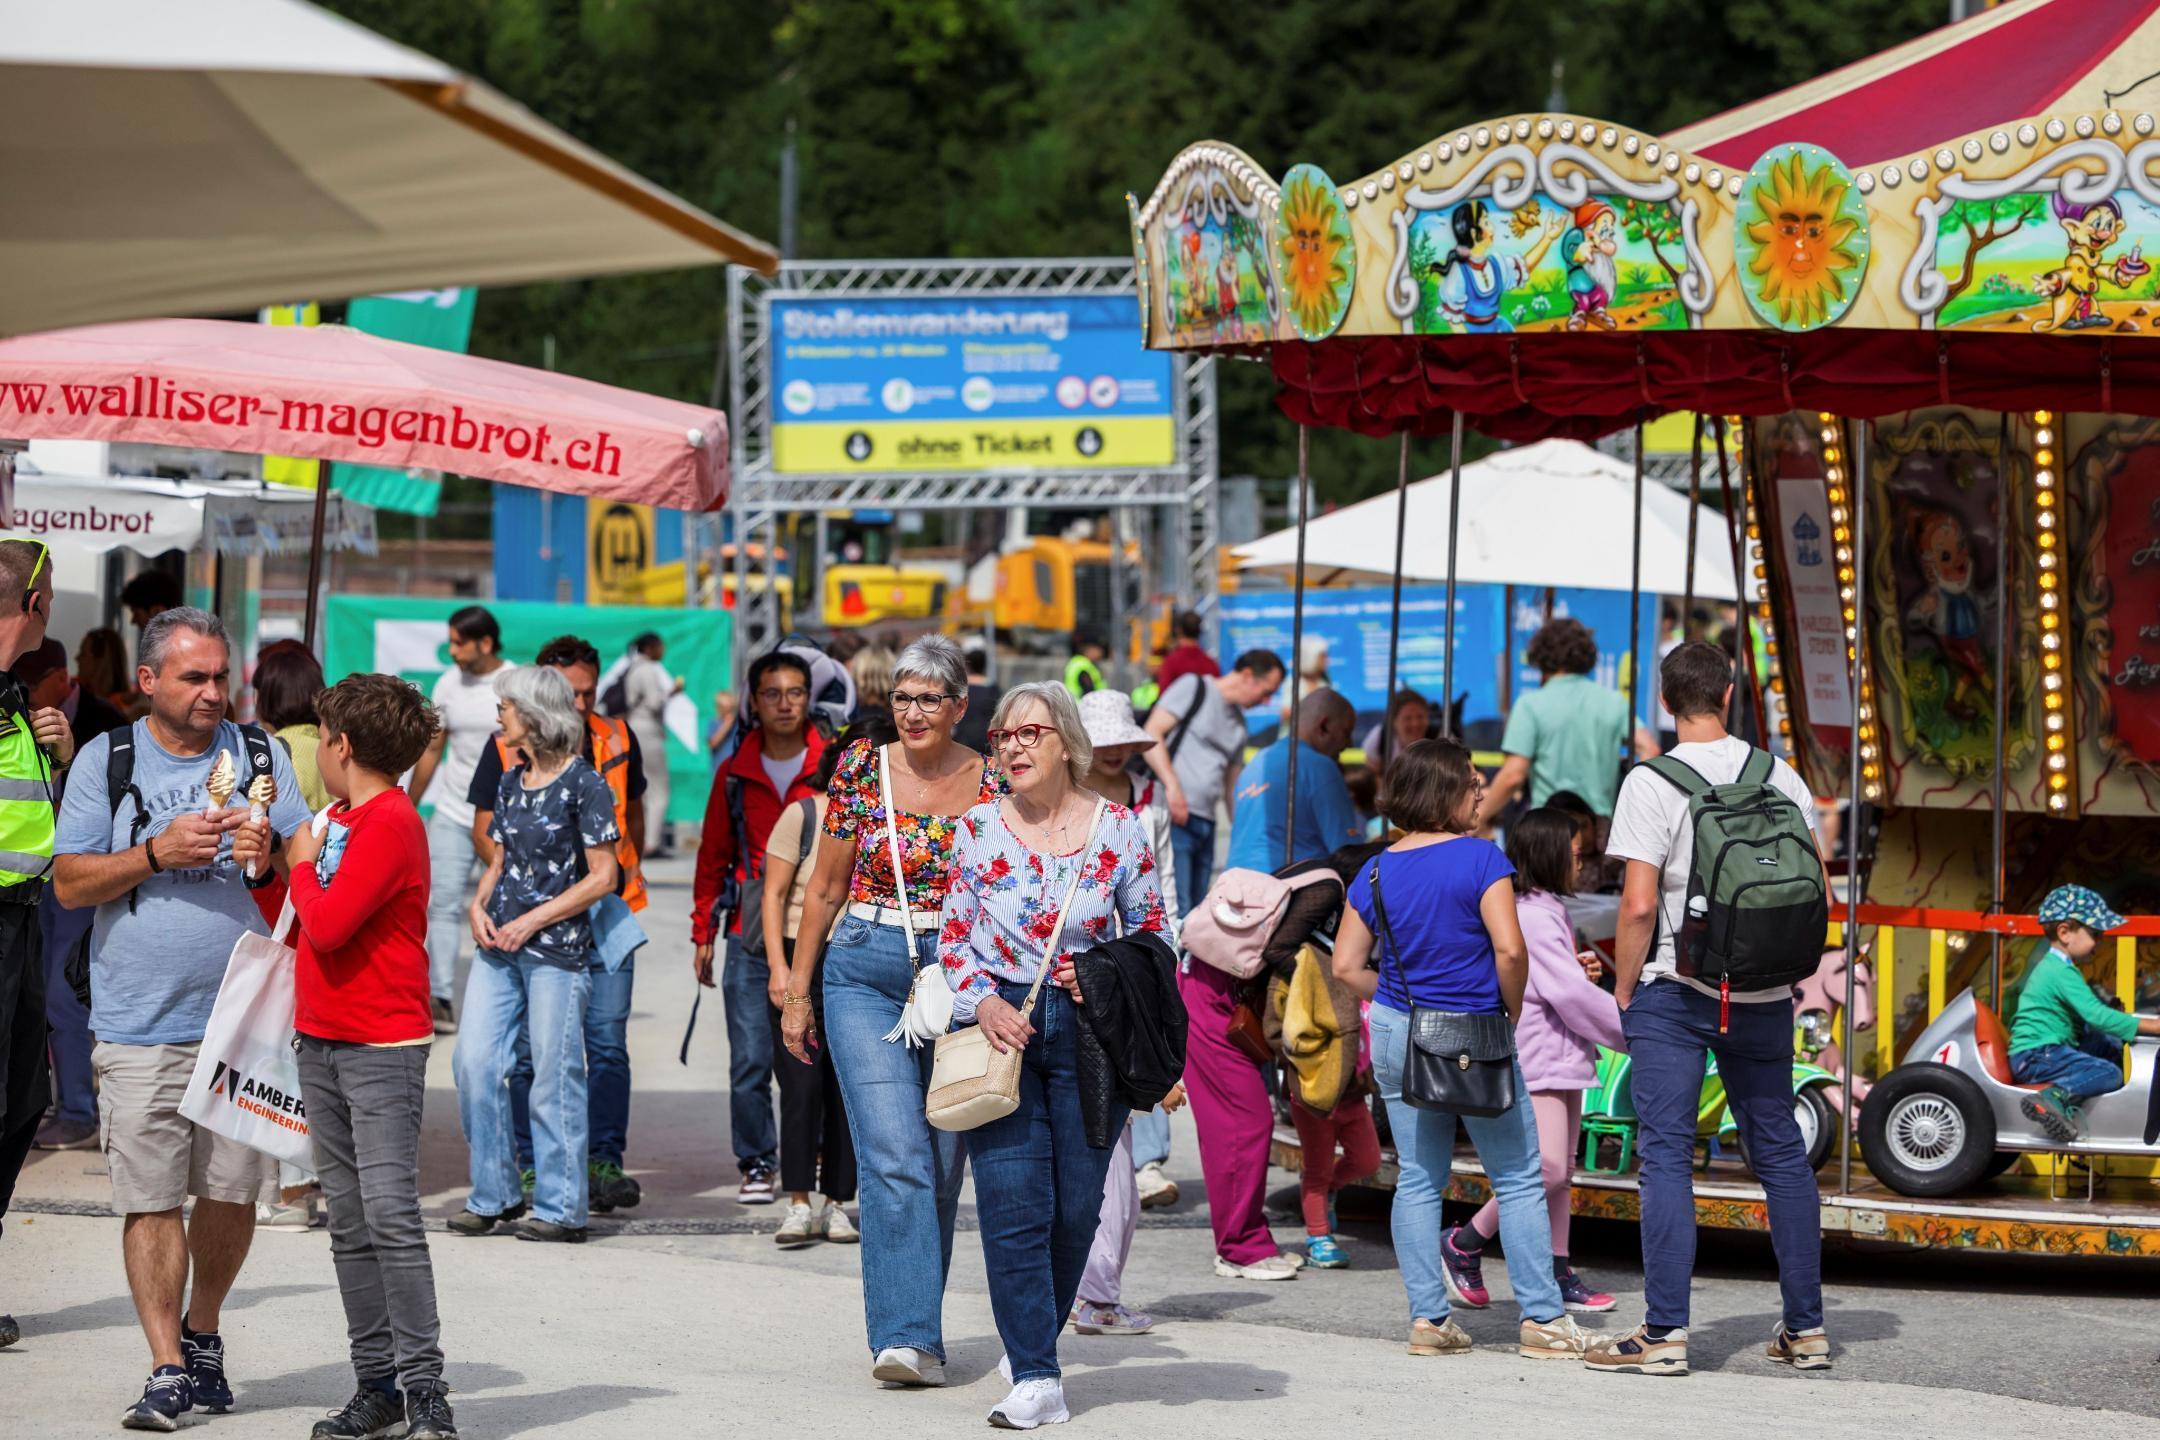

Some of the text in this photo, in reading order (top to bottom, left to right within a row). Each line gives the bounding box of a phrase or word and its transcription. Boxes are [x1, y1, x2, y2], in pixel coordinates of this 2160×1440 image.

[974, 432, 1052, 455] Ticket
[12, 506, 154, 535] agenbrot
[1938, 1045, 1951, 1065] 1
